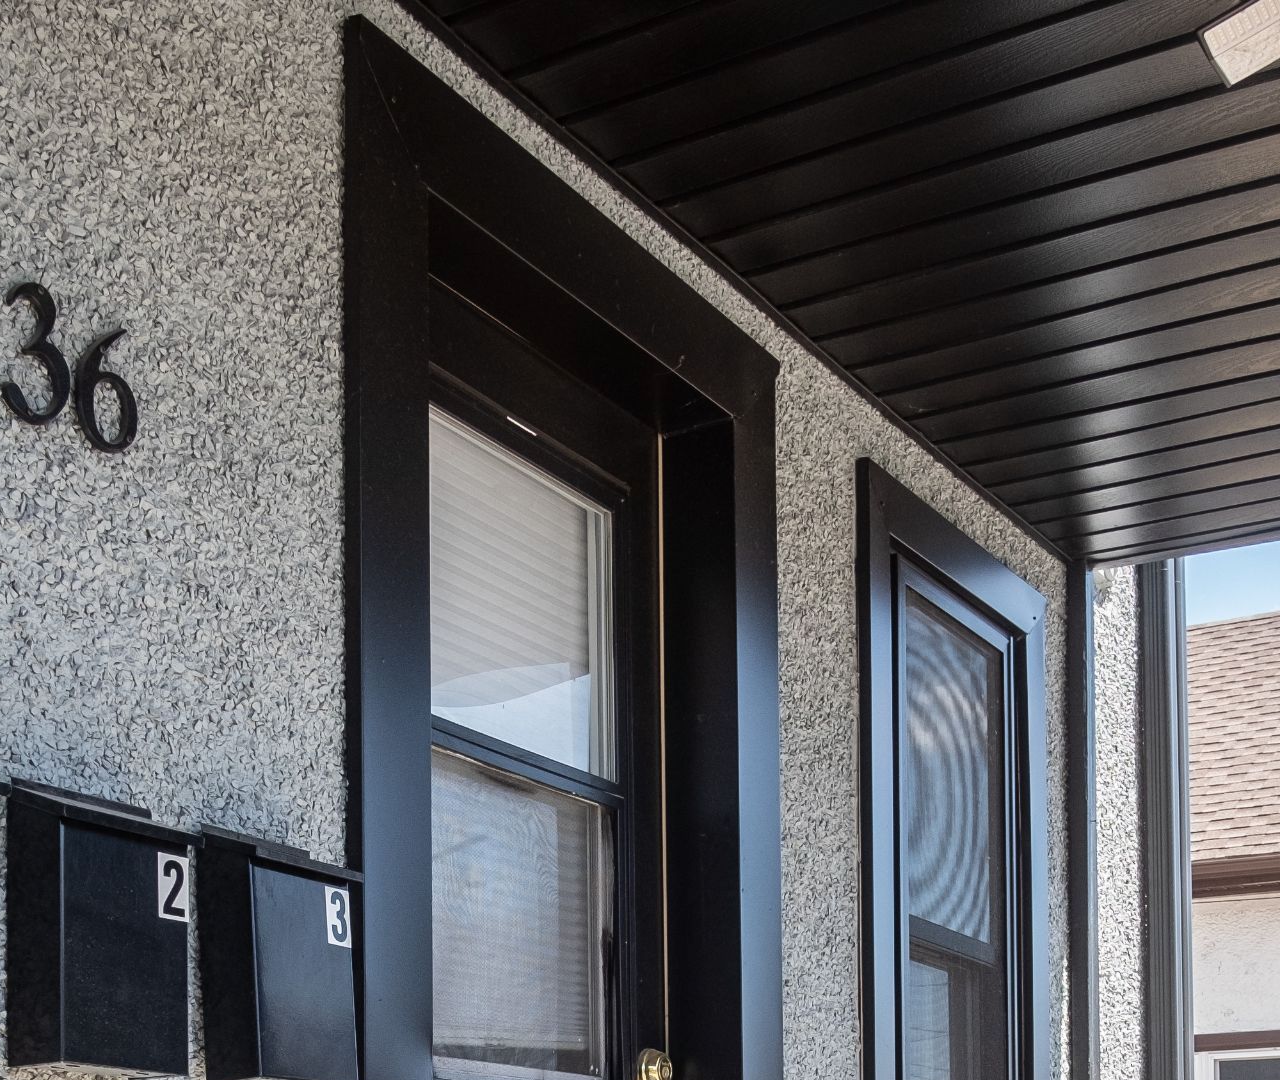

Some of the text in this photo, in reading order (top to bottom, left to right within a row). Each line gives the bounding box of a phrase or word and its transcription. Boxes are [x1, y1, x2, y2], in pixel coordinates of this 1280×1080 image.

[1, 281, 138, 453] 36
[164, 861, 186, 918] 2
[331, 890, 347, 942] 3
